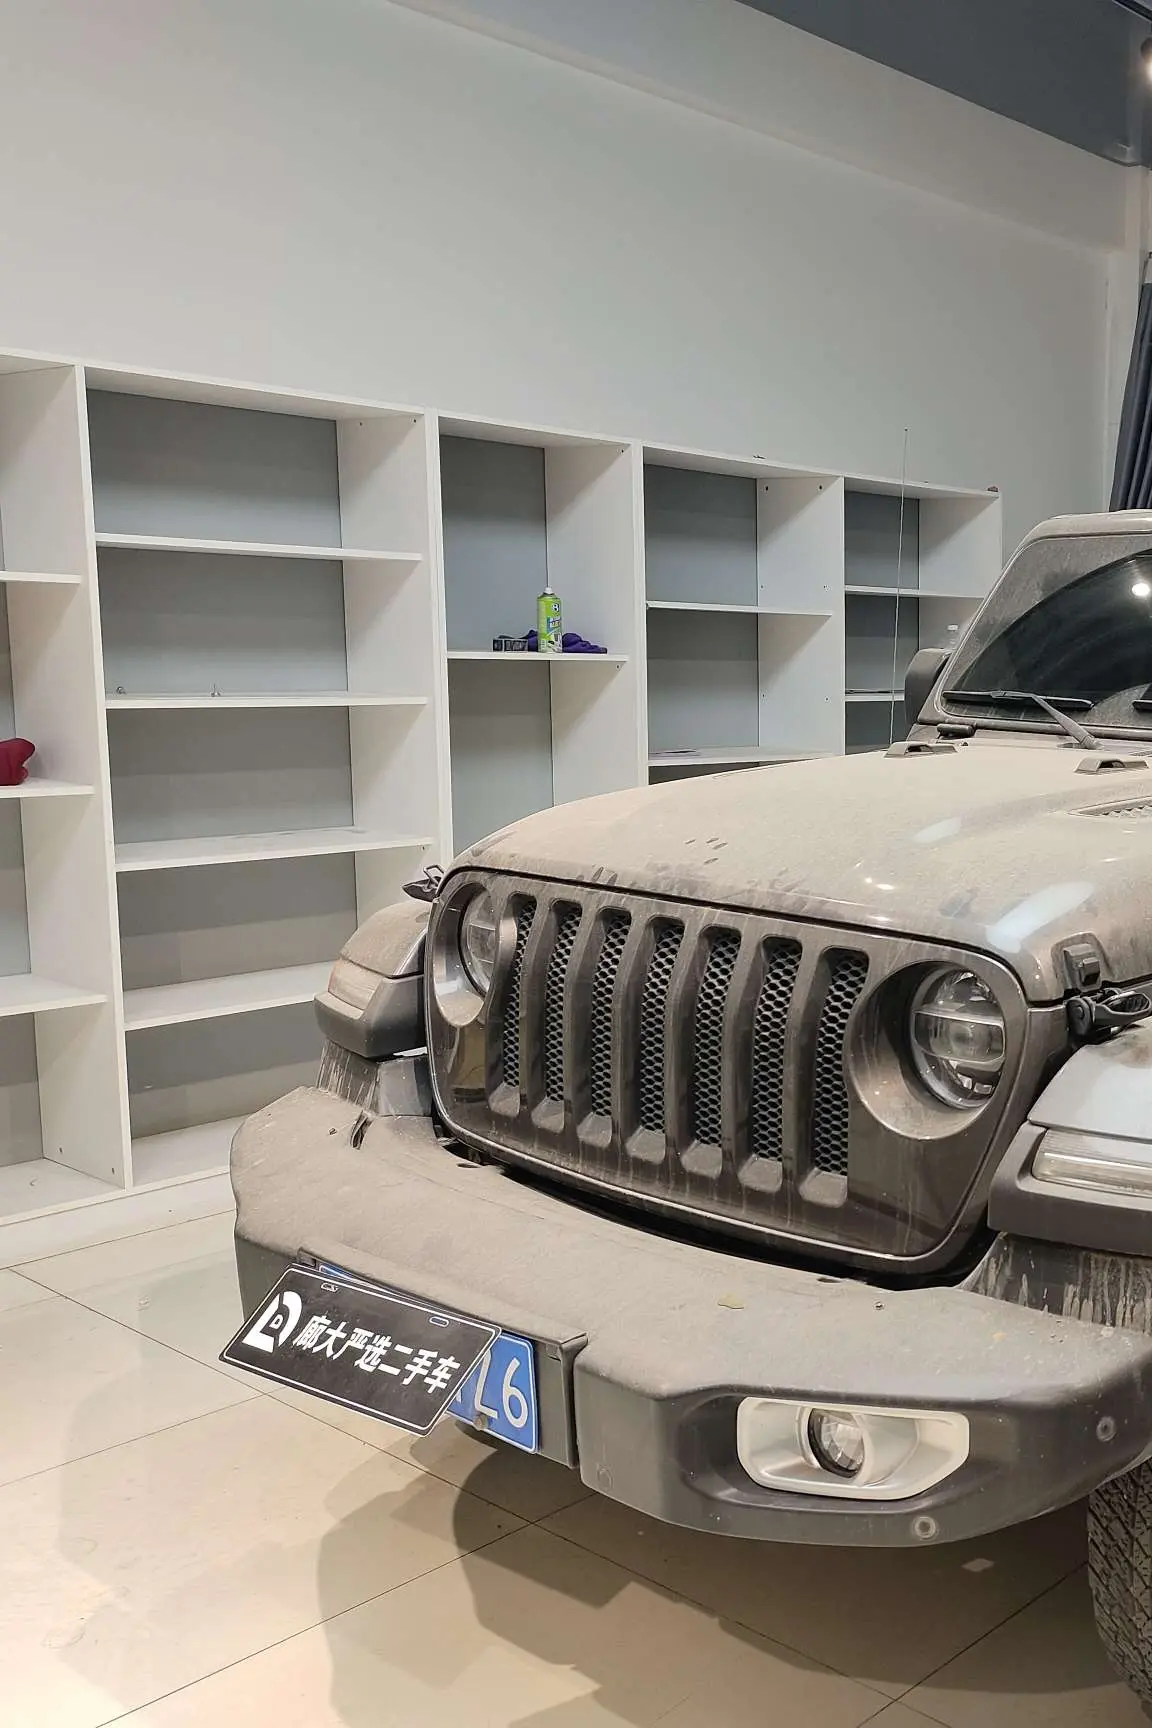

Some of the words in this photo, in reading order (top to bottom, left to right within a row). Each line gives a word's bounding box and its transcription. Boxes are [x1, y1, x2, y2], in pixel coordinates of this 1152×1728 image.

[292, 1311, 461, 1395] 廊大严选二手车
